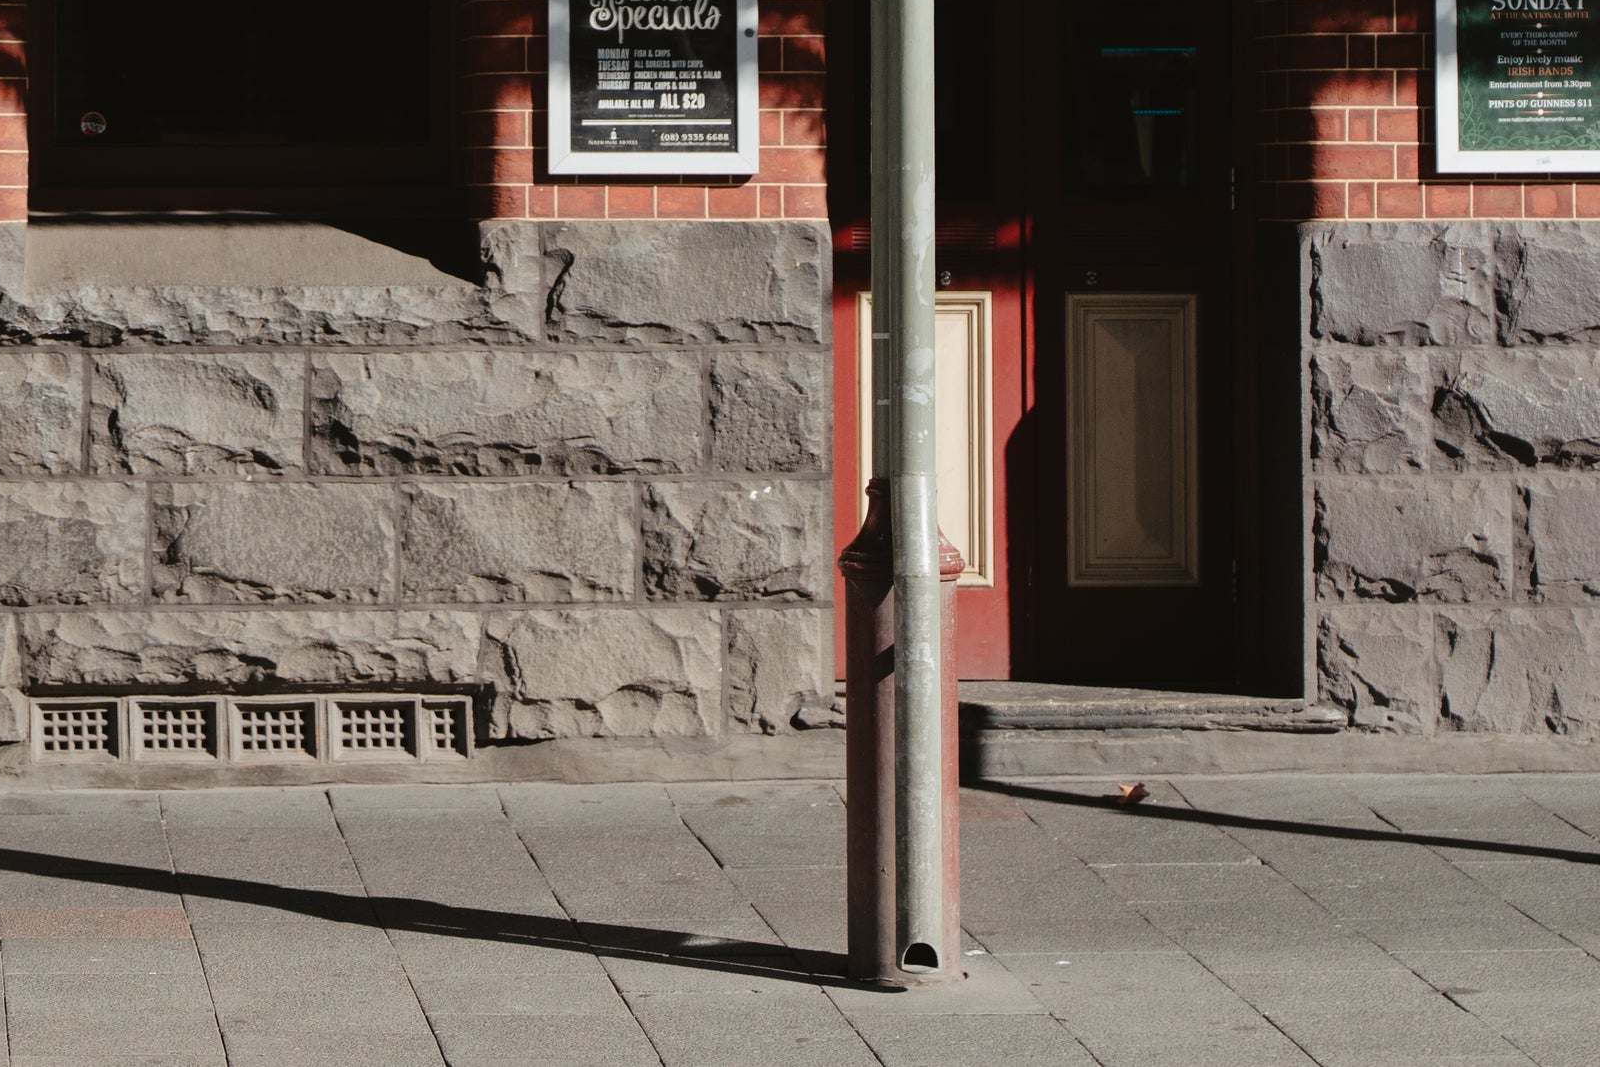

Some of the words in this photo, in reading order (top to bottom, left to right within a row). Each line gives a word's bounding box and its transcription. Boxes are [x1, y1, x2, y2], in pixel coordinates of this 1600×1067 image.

[1522, 12, 1562, 20] NATIONAL
[1549, 31, 1579, 39] SUNDAY
[598, 49, 630, 59] MONDAY
[634, 49, 647, 57] FISH
[654, 49, 671, 57] CHIPS
[1498, 55, 1524, 65] Enjoy
[1526, 55, 1552, 65] lively
[1555, 55, 1583, 63] music
[598, 60, 630, 71] TUESDAY
[634, 60, 644, 68] ALL
[687, 60, 704, 68] CHIPS
[598, 72, 631, 80] WEDNESDAY
[634, 71, 658, 79] CHICKEN
[680, 71, 696, 79] CHIPS
[703, 71, 722, 79] SALAD
[1508, 68, 1535, 76] IRISH
[1539, 67, 1574, 76] BANDS
[598, 81, 630, 90] THURSDAY
[654, 82, 671, 90] CHIPS
[678, 82, 697, 90] SALAD
[1490, 81, 1543, 89] Entertainment
[1544, 80, 1563, 88] from
[1564, 80, 1592, 90] 3.30pm
[598, 100, 630, 110] AVAILABLE
[630, 100, 642, 109] ALL
[642, 100, 655, 109] DAY
[660, 93, 681, 110] ALL
[683, 93, 706, 110] $20
[1489, 100, 1515, 109] PINTS
[1516, 100, 1529, 108] OF
[1530, 99, 1576, 108] GUINNESS
[1577, 99, 1592, 107] $11
[661, 133, 680, 142] (08)
[682, 133, 705, 142] 9335
[706, 133, 730, 142] 6688
